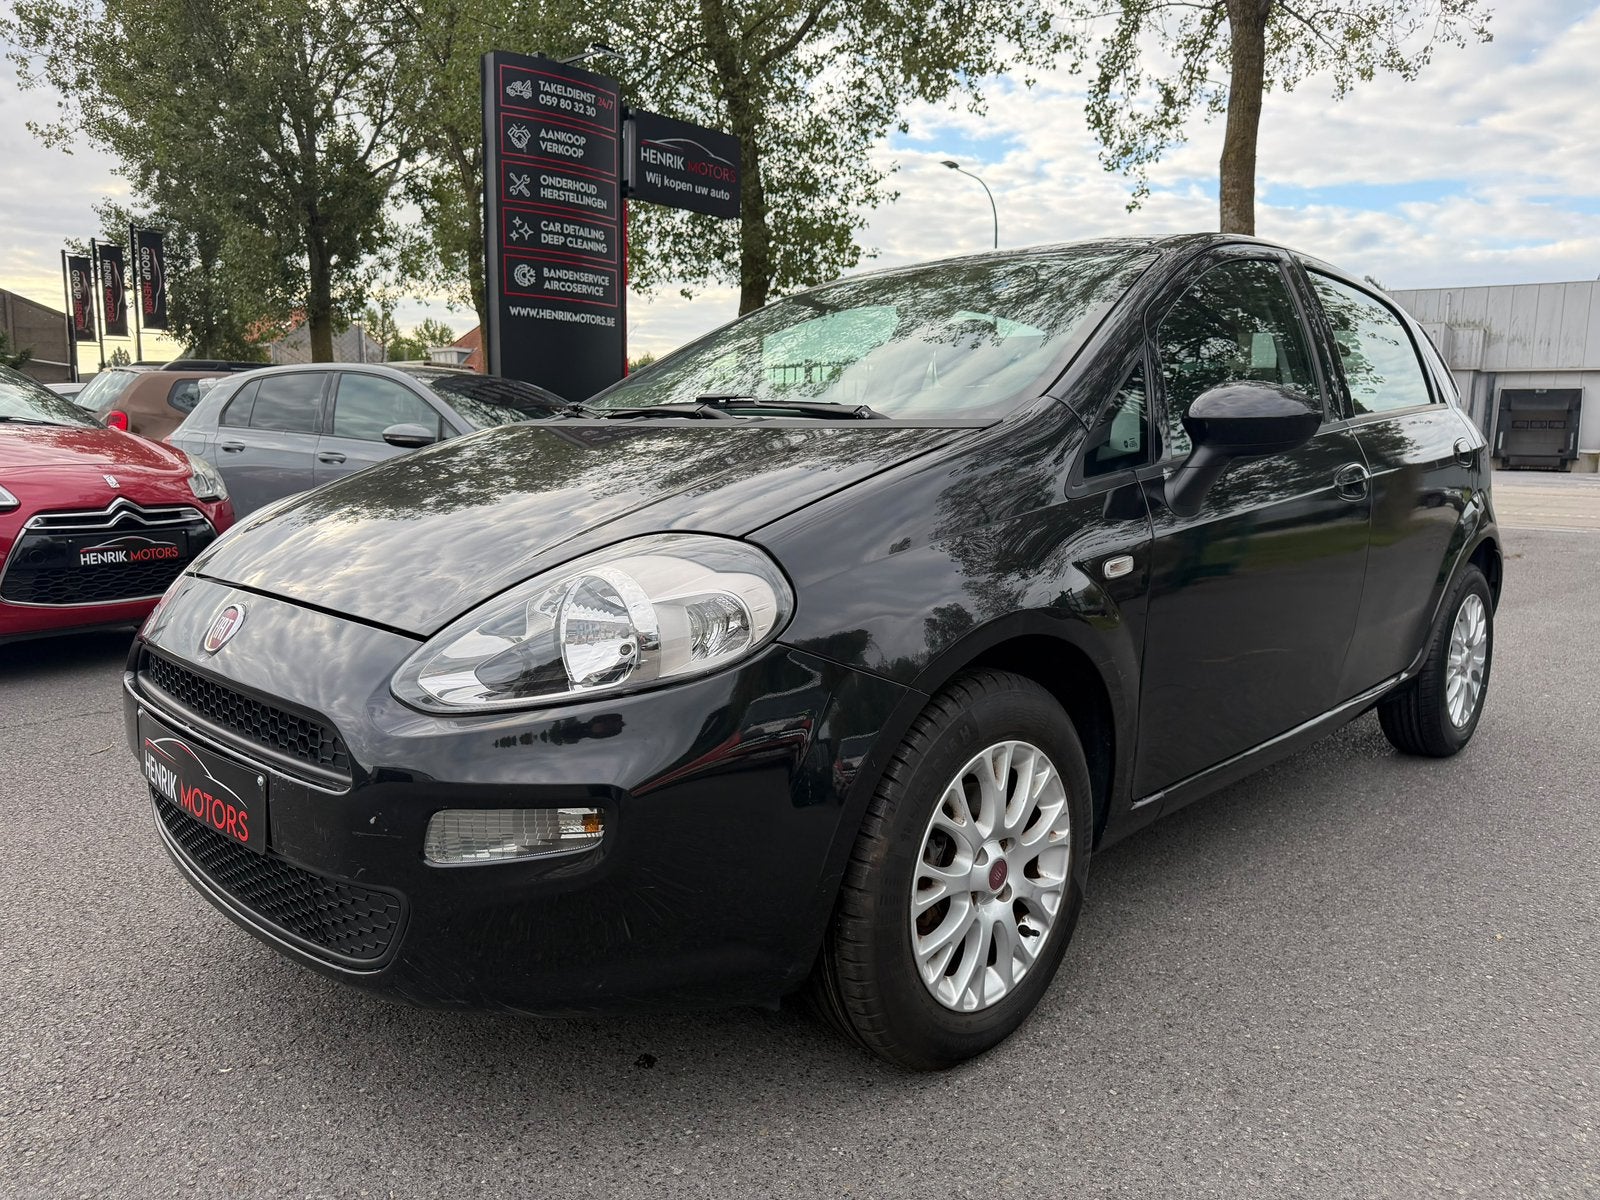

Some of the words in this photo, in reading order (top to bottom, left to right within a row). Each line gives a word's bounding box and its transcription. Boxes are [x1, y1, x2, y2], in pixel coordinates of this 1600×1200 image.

[538, 80, 596, 104] TAKELDIENST
[597, 96, 614, 110] 24/7
[538, 94, 558, 107] 059
[559, 98, 572, 110] 80
[573, 102, 585, 114] 32
[585, 105, 597, 117] 30
[539, 128, 587, 147] AANKOOP
[539, 140, 584, 158] VERKOOP
[640, 146, 685, 171] HENRIK
[687, 160, 737, 183] MOTORS
[540, 174, 598, 195] ONDERHOUD
[645, 170, 662, 188] Wij
[663, 175, 693, 192] kopen
[694, 184, 709, 196] uw
[710, 188, 730, 200] auto
[540, 187, 608, 210] HERSTELLINGEN
[540, 220, 562, 233] CAR
[563, 223, 605, 241] DETAILING
[540, 233, 565, 246] DEEP
[566, 237, 608, 253] CLEANING
[102, 259, 113, 288] HENRIK
[140, 246, 151, 281] GROUP
[71, 269, 82, 300] GROUP
[542, 267, 610, 286] BANDENSERVICE
[143, 281, 154, 316] HENRIK
[543, 280, 604, 297] AIRCOSERVICE
[105, 287, 115, 323] MOTORS
[508, 305, 616, 327] WWW.HENRIKMOTORS.BE
[80, 550, 128, 565] HENRIK
[130, 546, 179, 561] MOTORS
[144, 749, 178, 803] HENRIK
[180, 779, 249, 842] MOTORS
